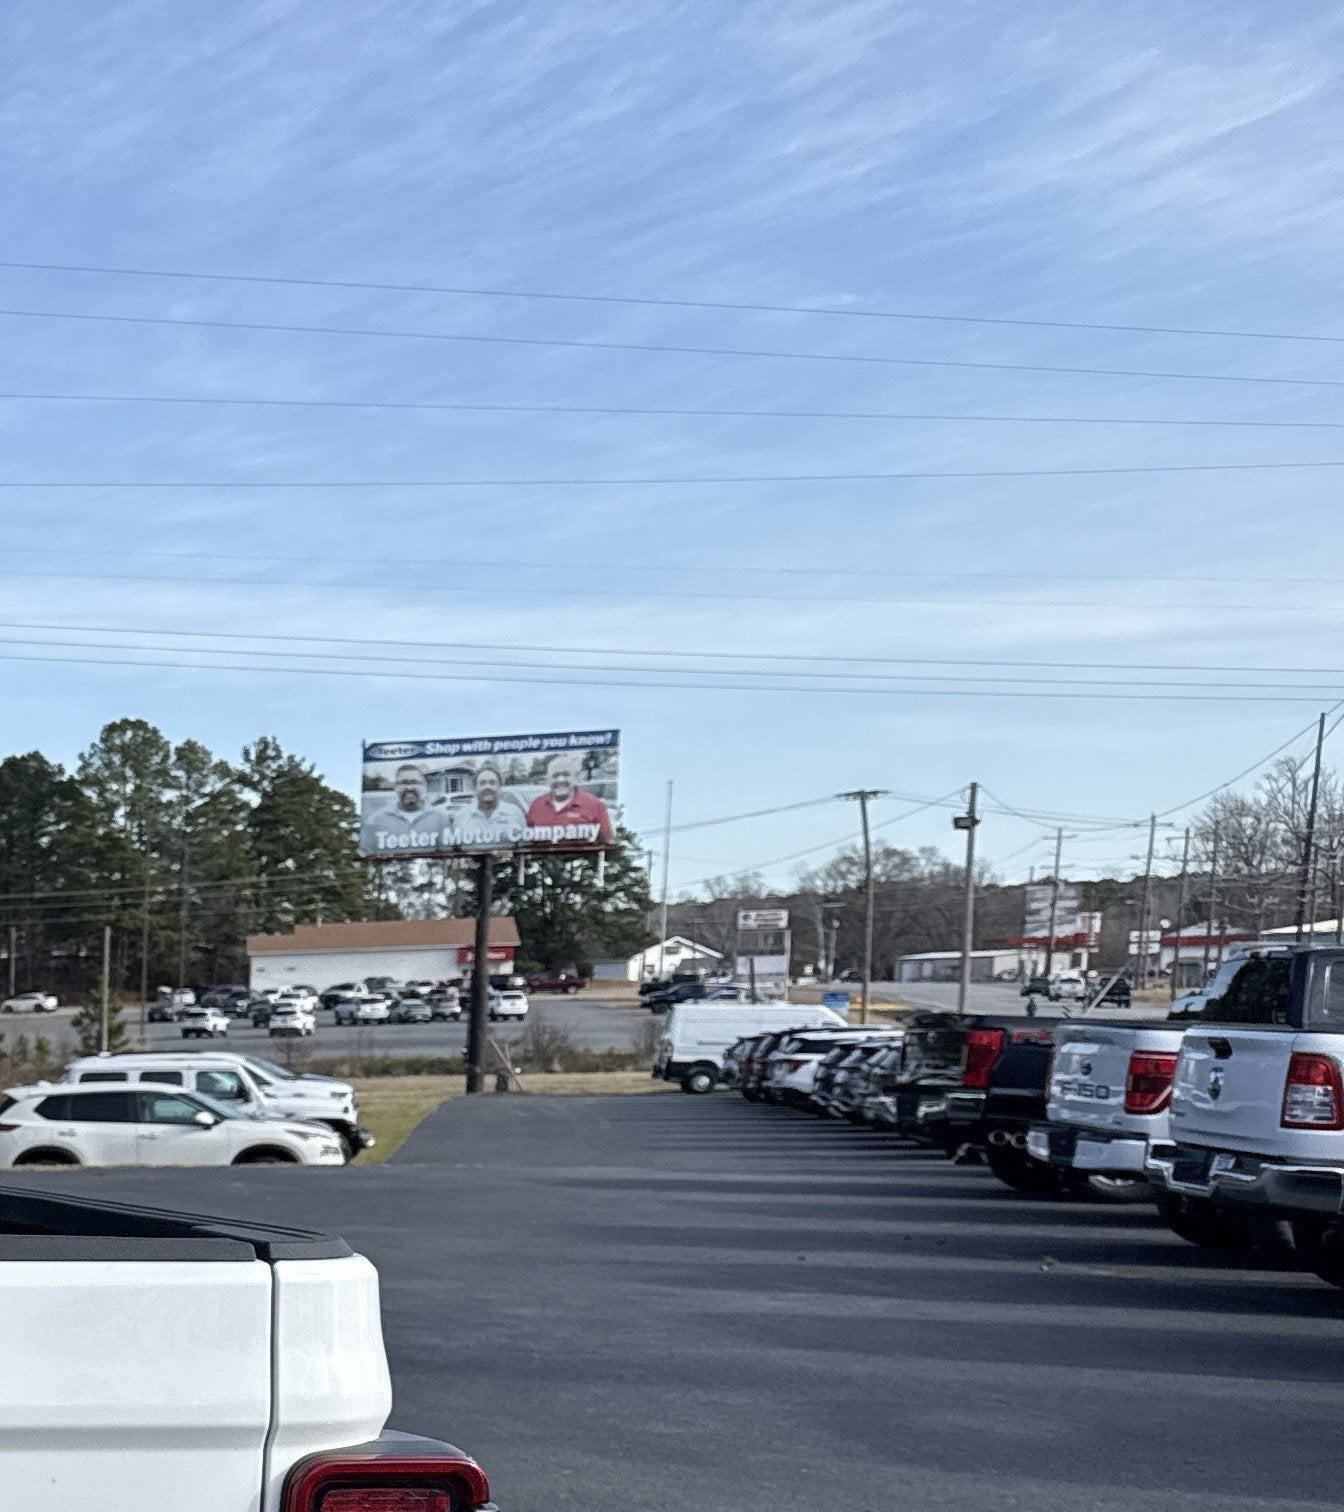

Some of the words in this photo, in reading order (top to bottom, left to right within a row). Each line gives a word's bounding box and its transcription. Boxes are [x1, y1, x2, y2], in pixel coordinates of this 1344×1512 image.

[425, 741, 460, 755] Shop
[461, 739, 492, 752] with
[493, 736, 541, 753] people
[541, 737, 568, 750] you
[376, 831, 439, 850] Teeter
[443, 827, 502, 846] Motor
[508, 823, 601, 843] Company
